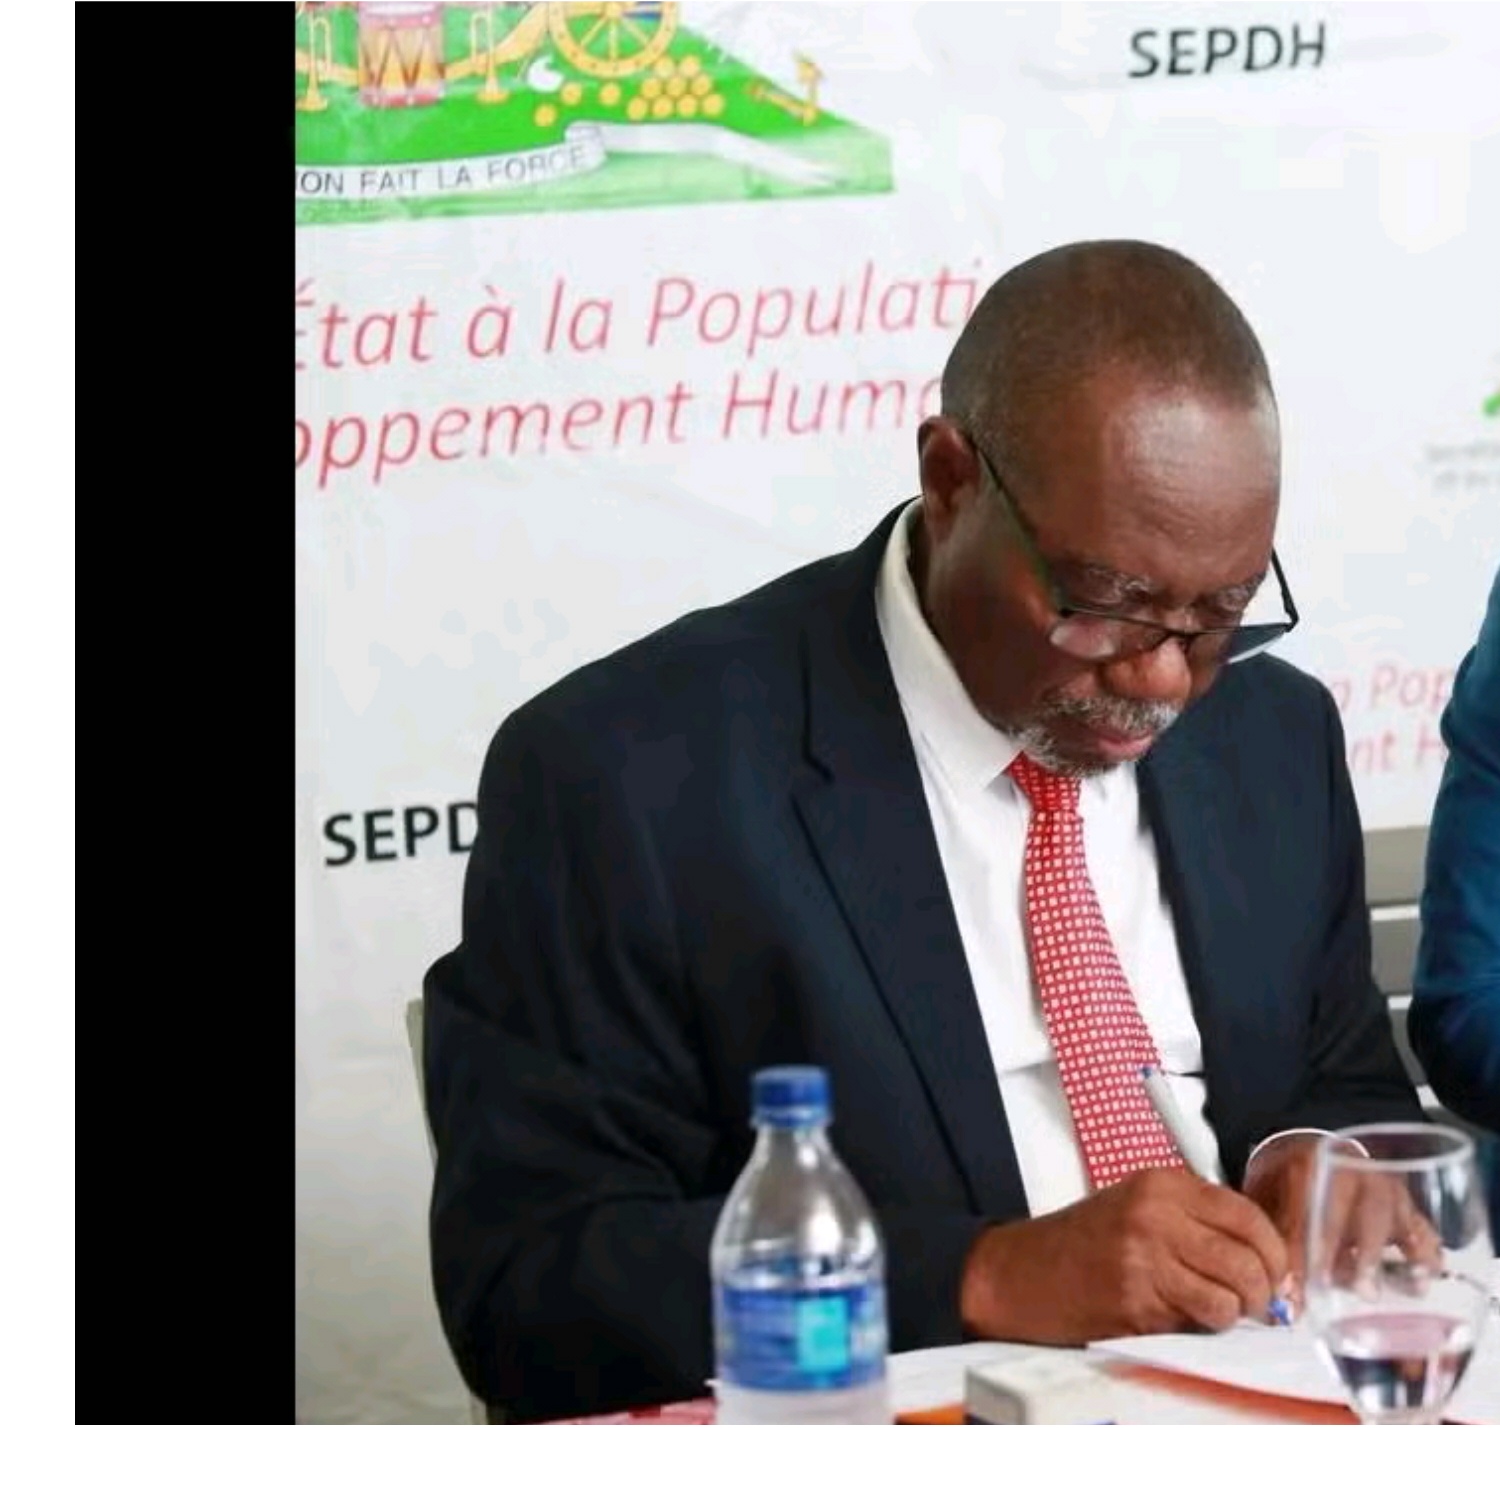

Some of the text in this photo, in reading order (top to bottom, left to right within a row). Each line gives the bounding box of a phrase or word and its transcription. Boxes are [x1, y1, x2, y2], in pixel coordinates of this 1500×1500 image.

[1129, 22, 1325, 78] SEPDH
[296, 145, 584, 195] ON FAIT LA FORCE
[466, 284, 512, 359] à
[543, 277, 613, 353] la
